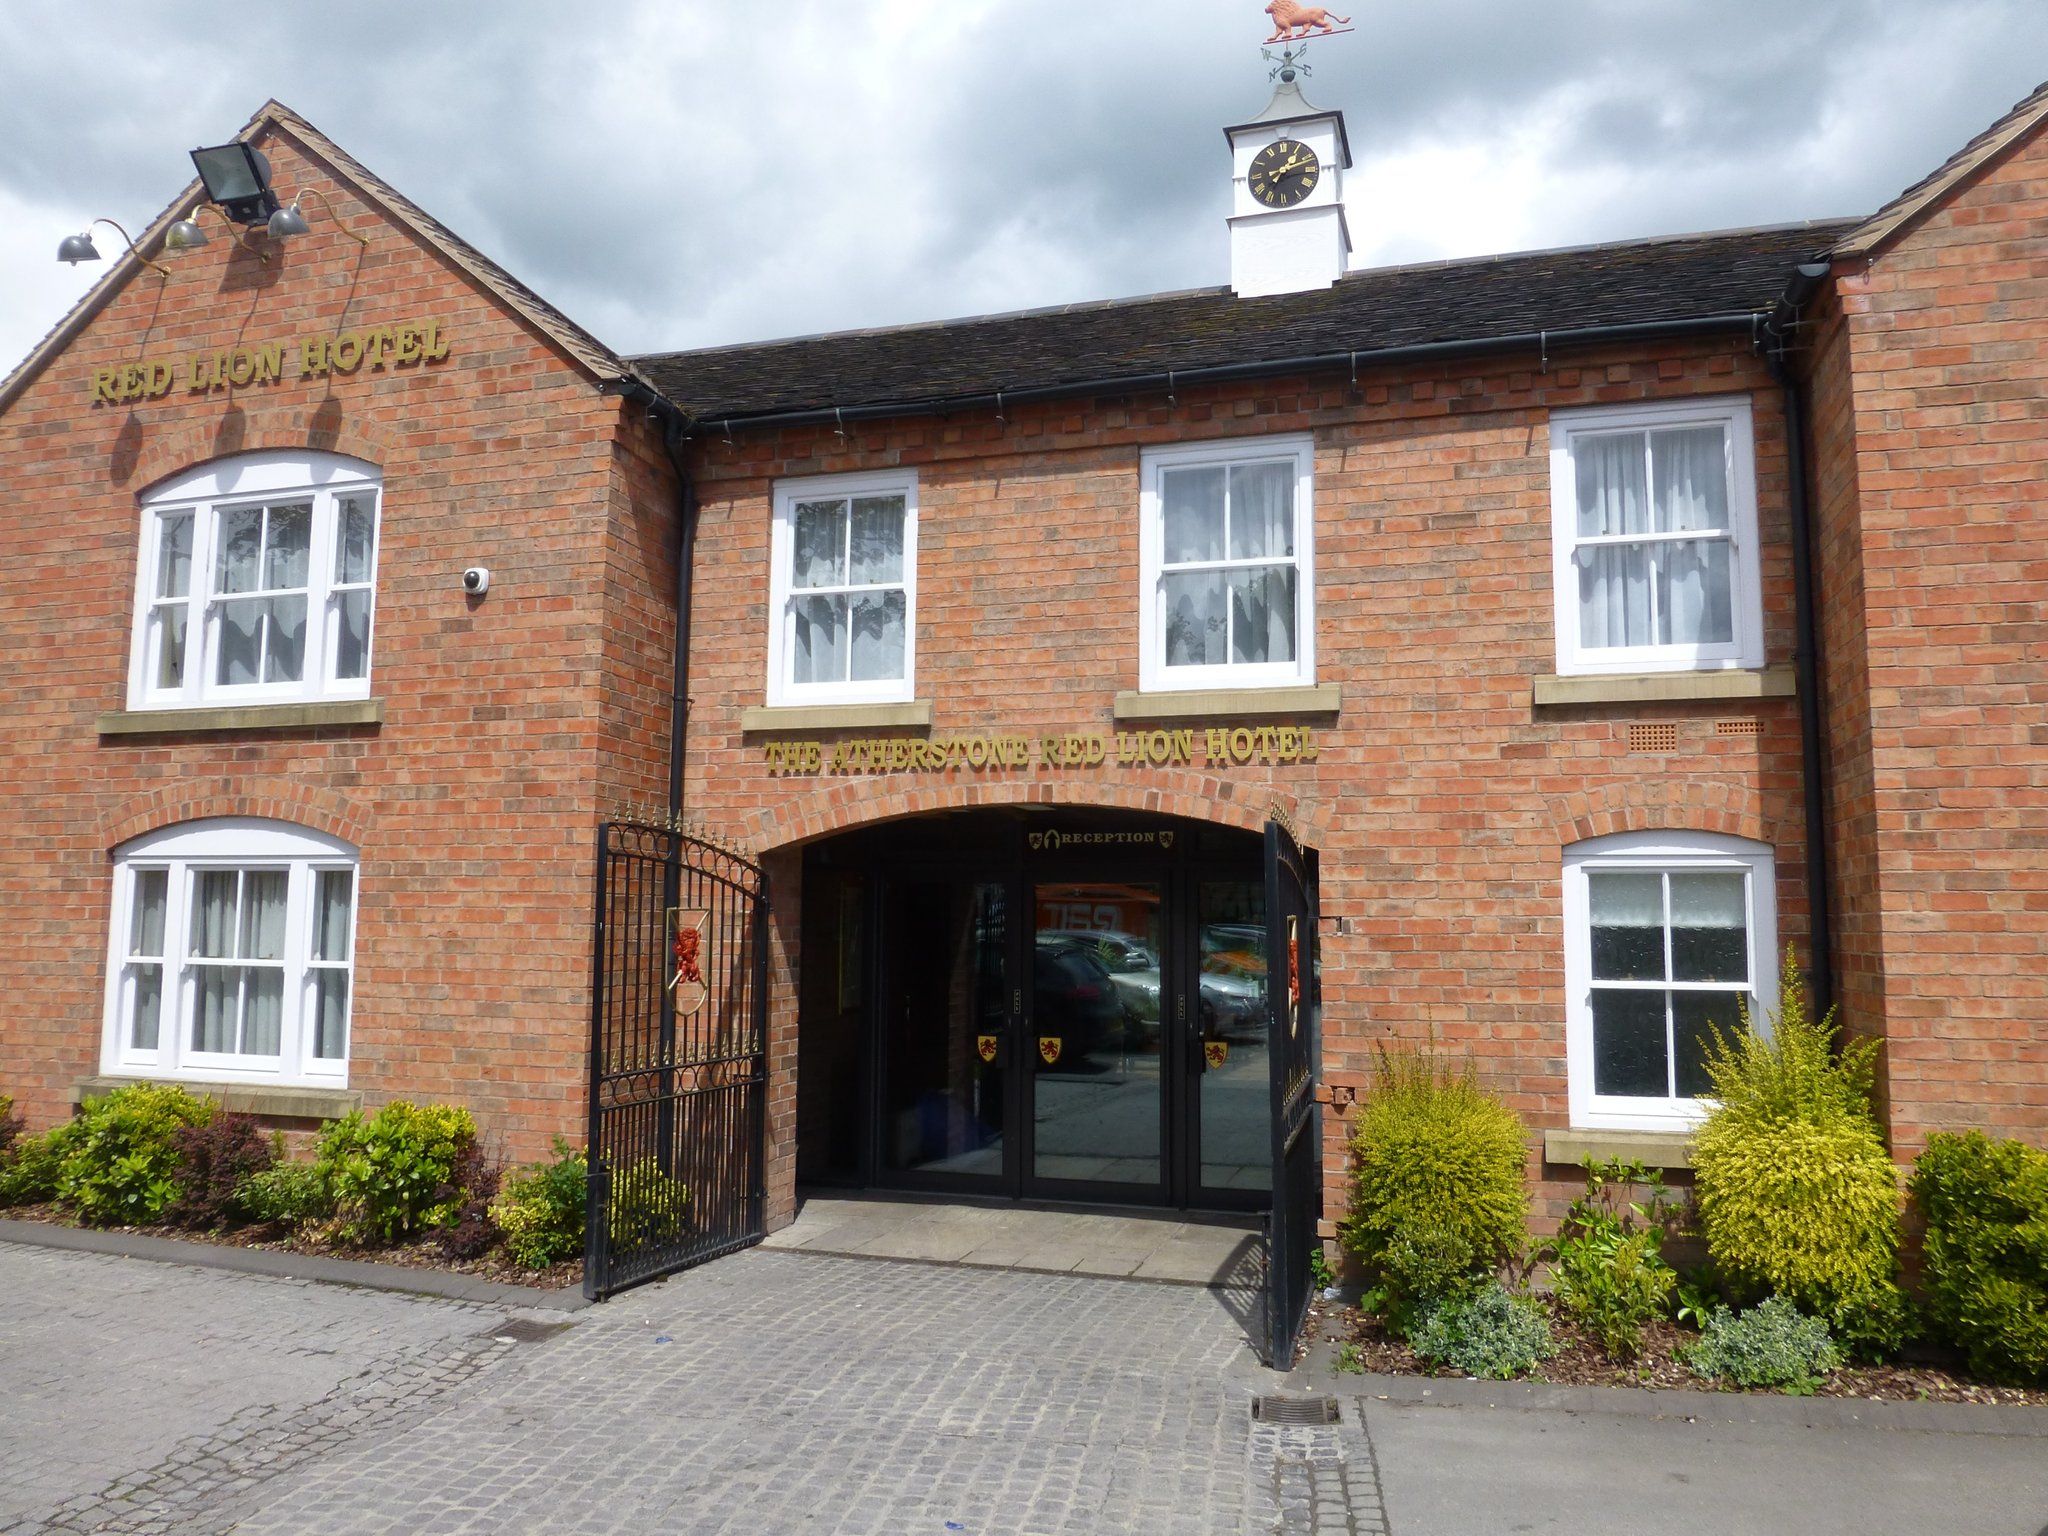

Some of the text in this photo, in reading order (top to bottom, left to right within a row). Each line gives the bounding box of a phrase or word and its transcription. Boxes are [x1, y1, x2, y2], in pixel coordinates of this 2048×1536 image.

[92, 318, 452, 402] RED LION HOTEL
[765, 726, 1320, 773] THE ATHERSTONE RED LION HOTEL
[1061, 831, 1156, 844] RECEPTION
